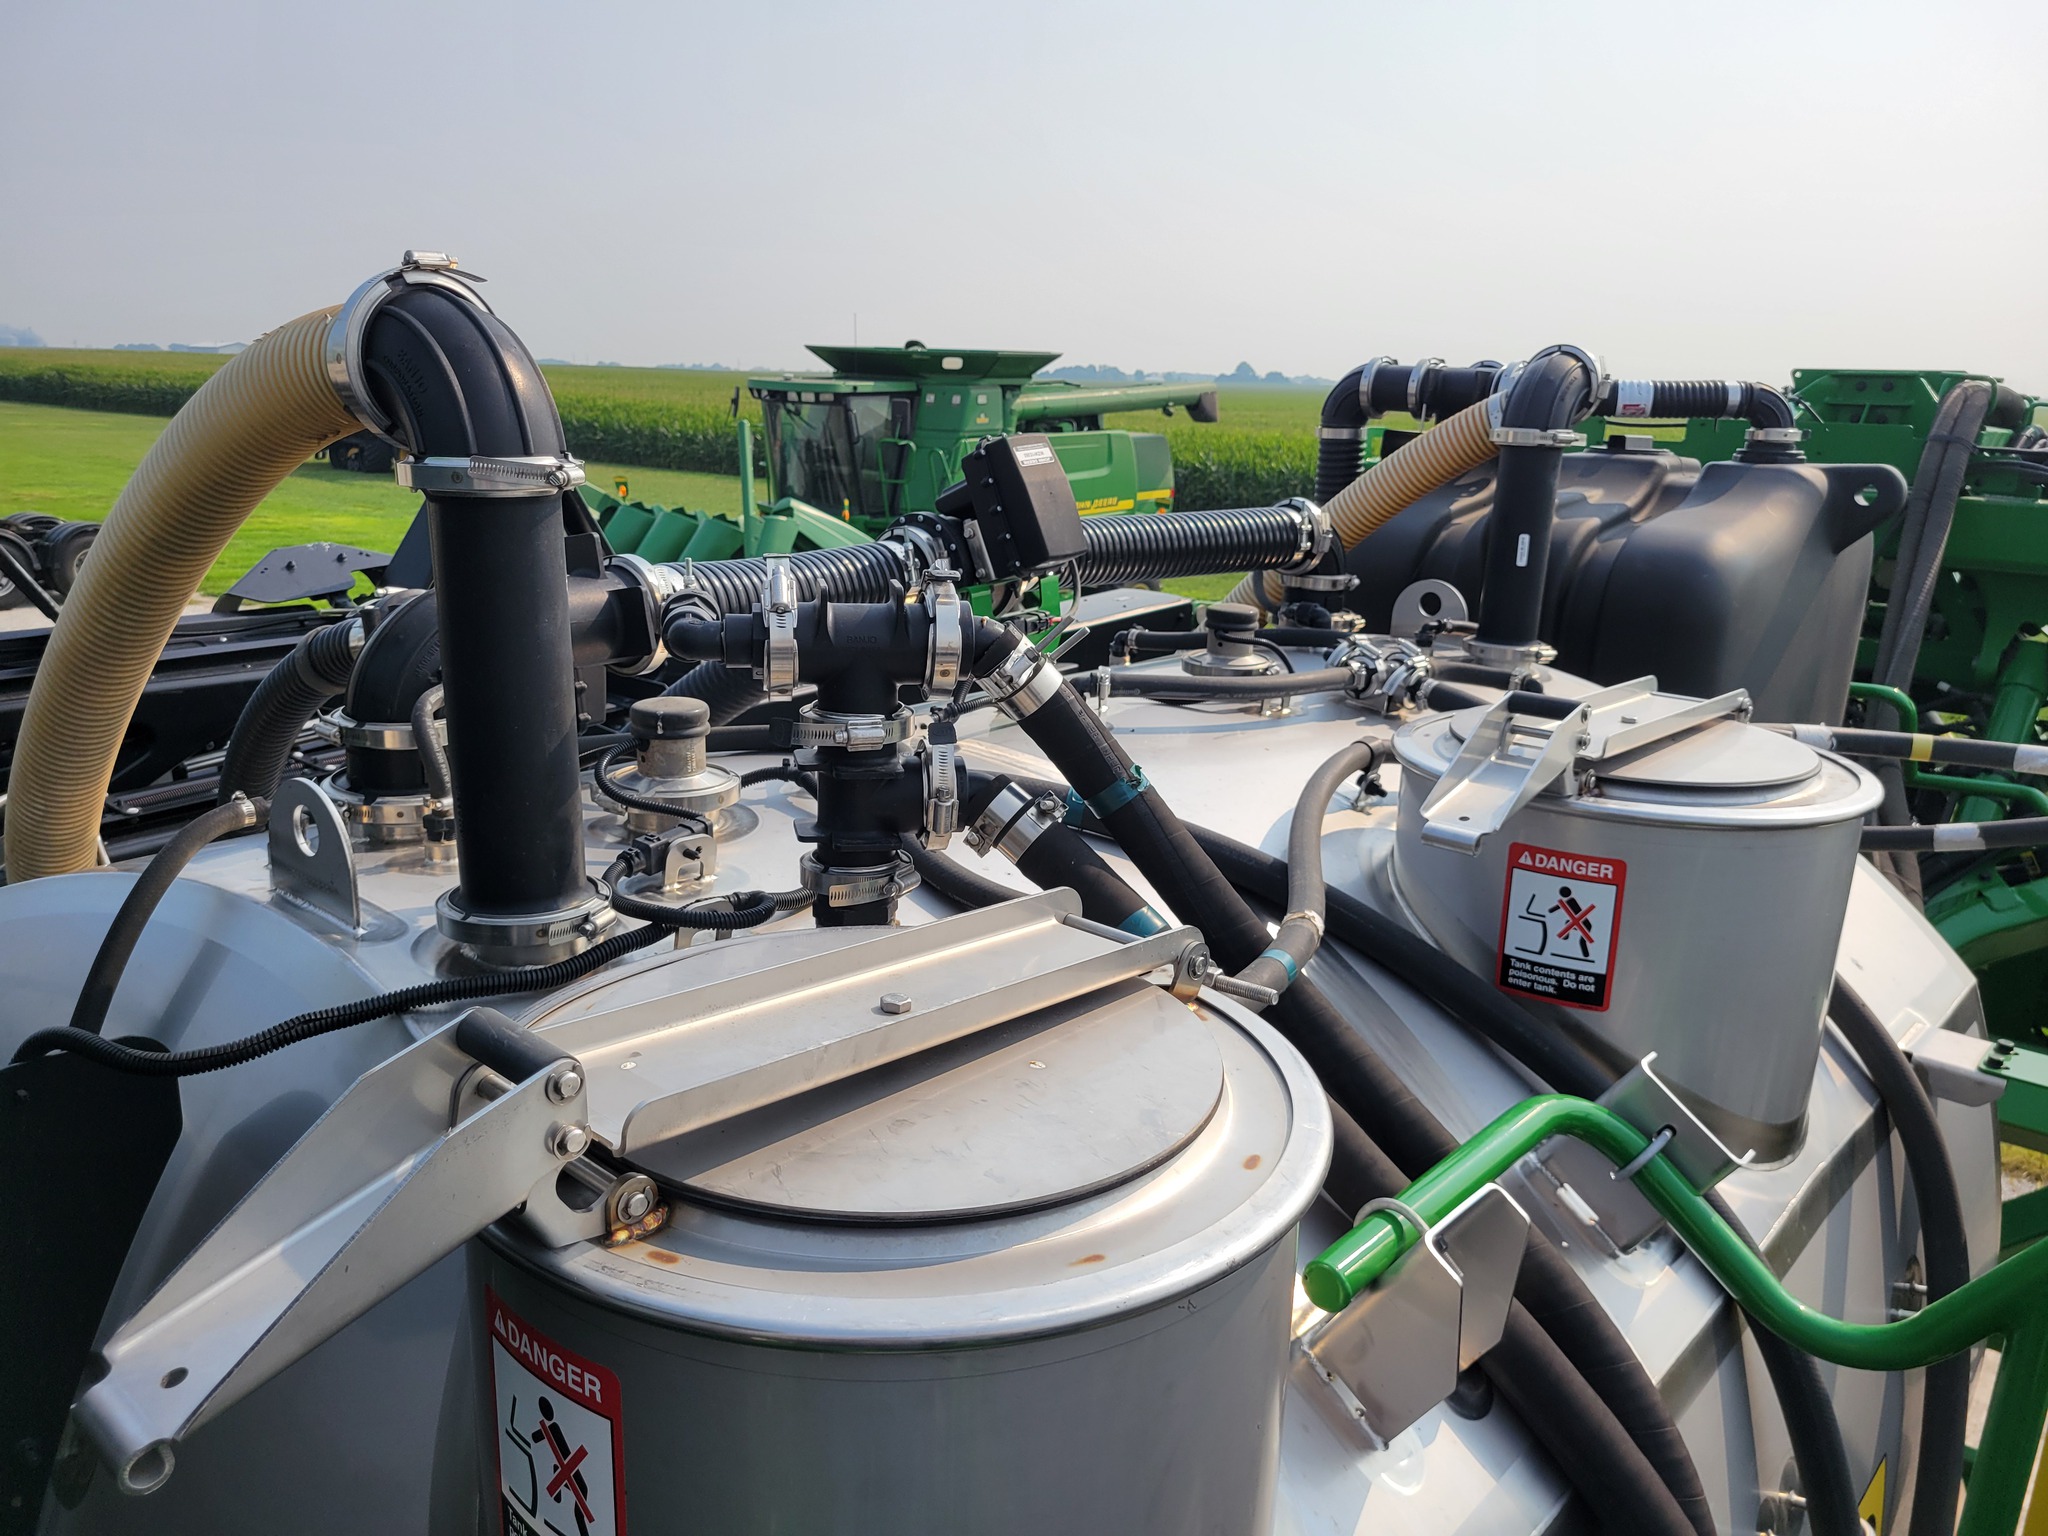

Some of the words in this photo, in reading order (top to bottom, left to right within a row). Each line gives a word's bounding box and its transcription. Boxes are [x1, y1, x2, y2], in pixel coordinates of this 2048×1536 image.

[1535, 853, 1613, 879] DANGER
[1508, 968, 1559, 986] poisonous.
[1562, 979, 1577, 989] Do
[1578, 983, 1596, 993] not
[1510, 958, 1531, 971] Tank
[1533, 965, 1576, 980] contents
[1578, 974, 1595, 983] are
[1507, 976, 1532, 989] enter
[1533, 982, 1557, 995] tank.
[508, 1318, 602, 1403] DANGER
[507, 1505, 528, 1536] Tank
